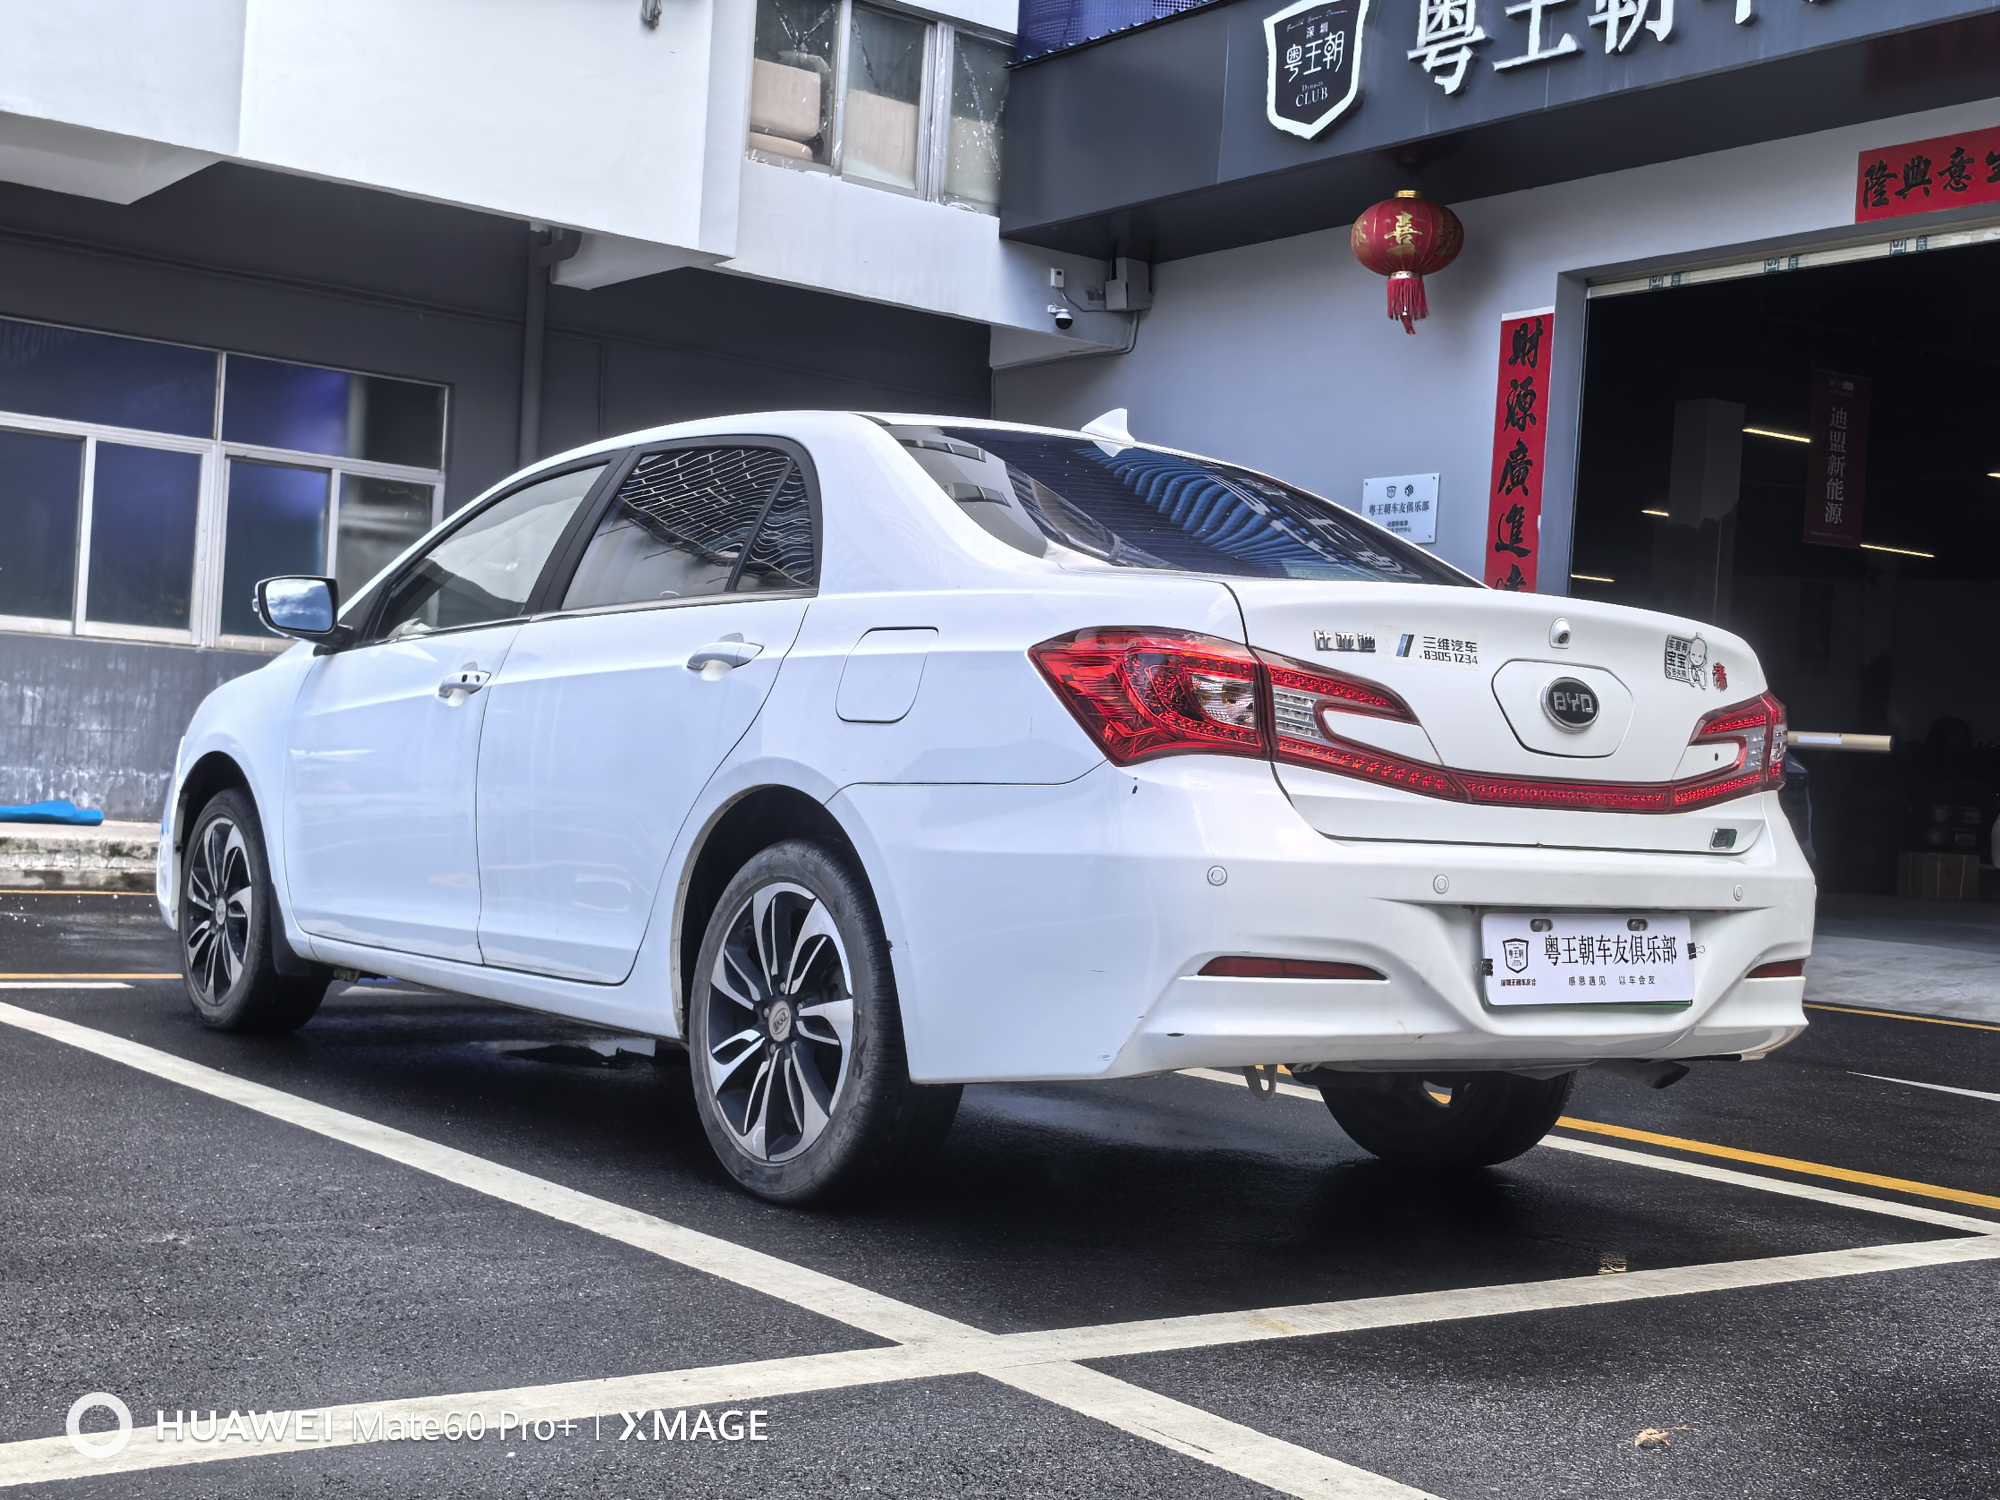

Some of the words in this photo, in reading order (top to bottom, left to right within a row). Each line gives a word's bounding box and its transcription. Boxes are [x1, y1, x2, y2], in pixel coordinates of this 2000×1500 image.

[1284, 30, 1345, 83] 粤王朝
[1295, 87, 1329, 108] CLUB
[1823, 406, 1848, 525] 迪盟新能源
[1313, 630, 1377, 653] 比亚迪
[1423, 636, 1478, 653] 三维汽车
[1552, 691, 1594, 713] BYD
[1543, 935, 1678, 966] 粤王朝车友俱乐部
[1568, 975, 1608, 986] 感恩遇见
